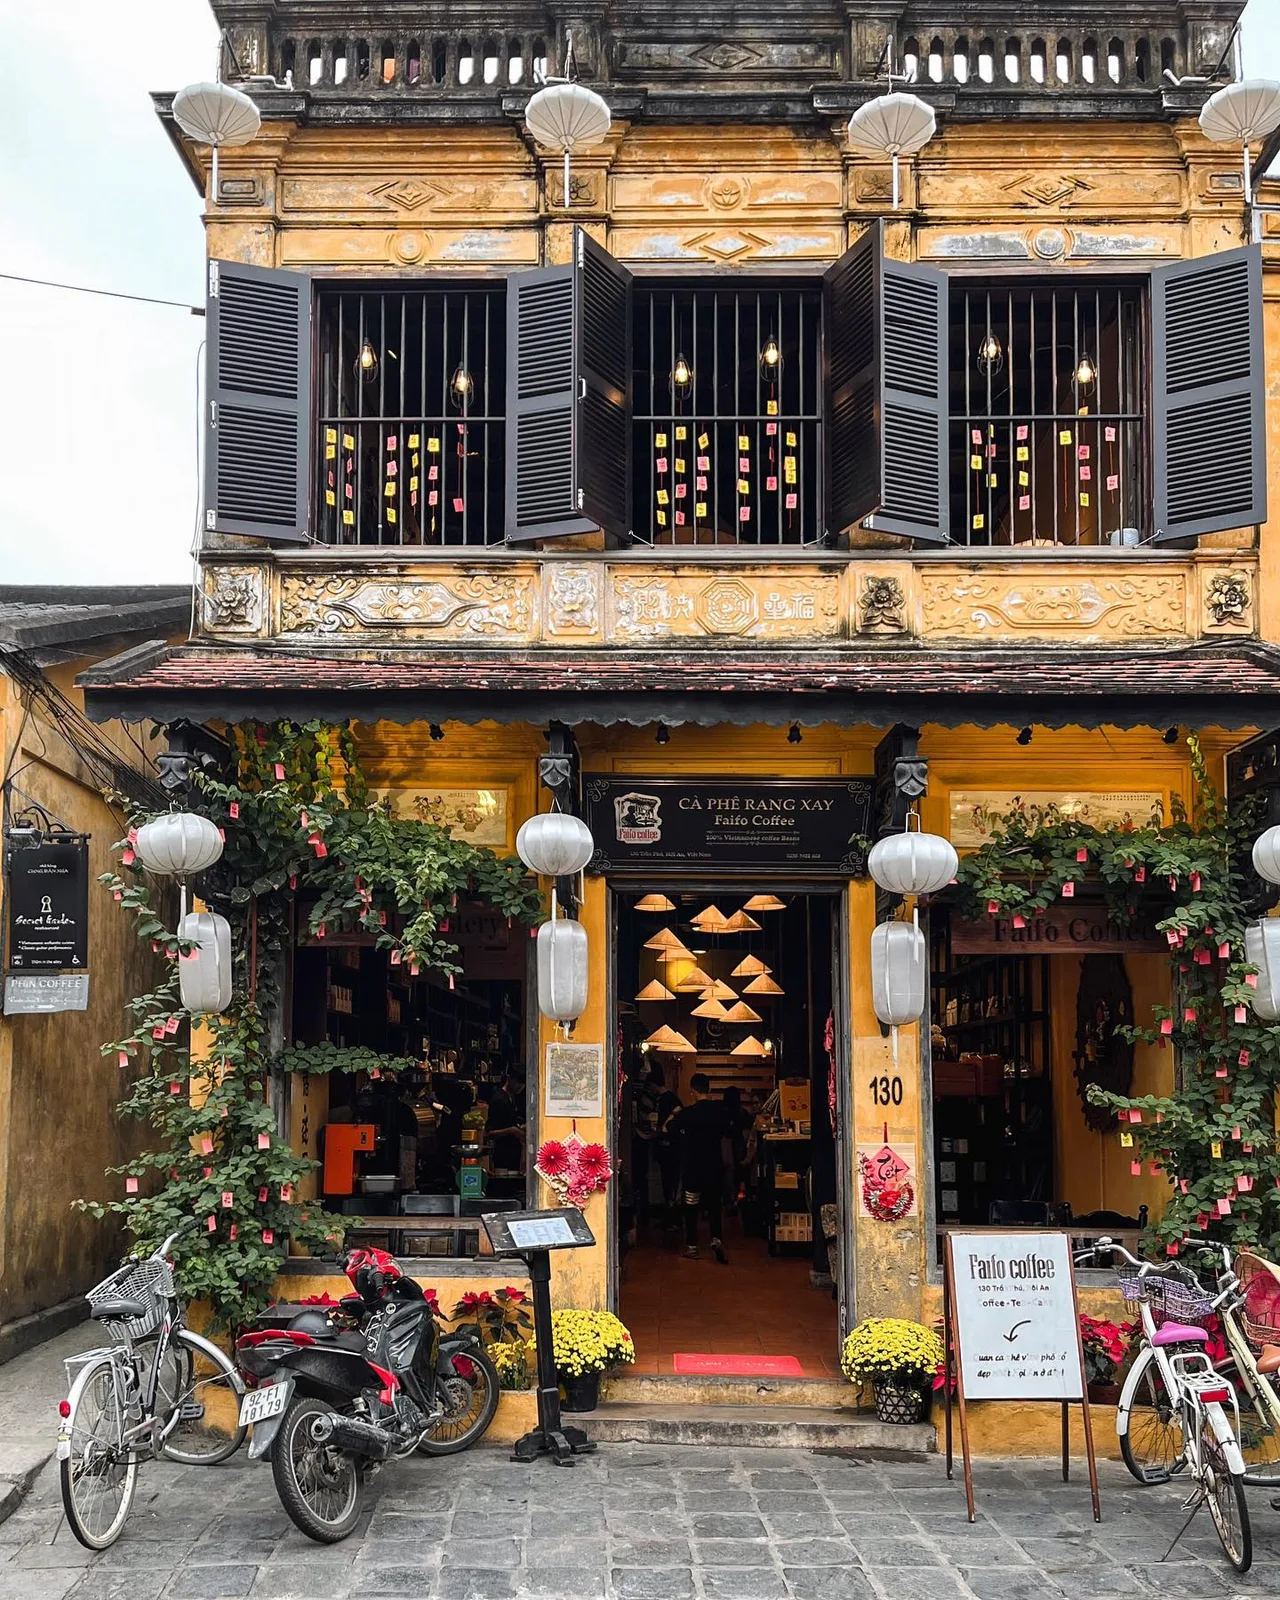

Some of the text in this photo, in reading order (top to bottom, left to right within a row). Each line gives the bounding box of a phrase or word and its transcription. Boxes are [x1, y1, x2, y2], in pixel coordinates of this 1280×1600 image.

[678, 795, 834, 811] CÀ PHÊ RANG XAY
[714, 814, 796, 826] Faifo Coffee
[39, 980, 82, 988] COFFEE
[869, 1076, 903, 1106] 130
[968, 1253, 1056, 1280] Faifo coffee
[248, 1386, 279, 1408] 92-F1
[244, 1399, 282, 1423] 181.79
